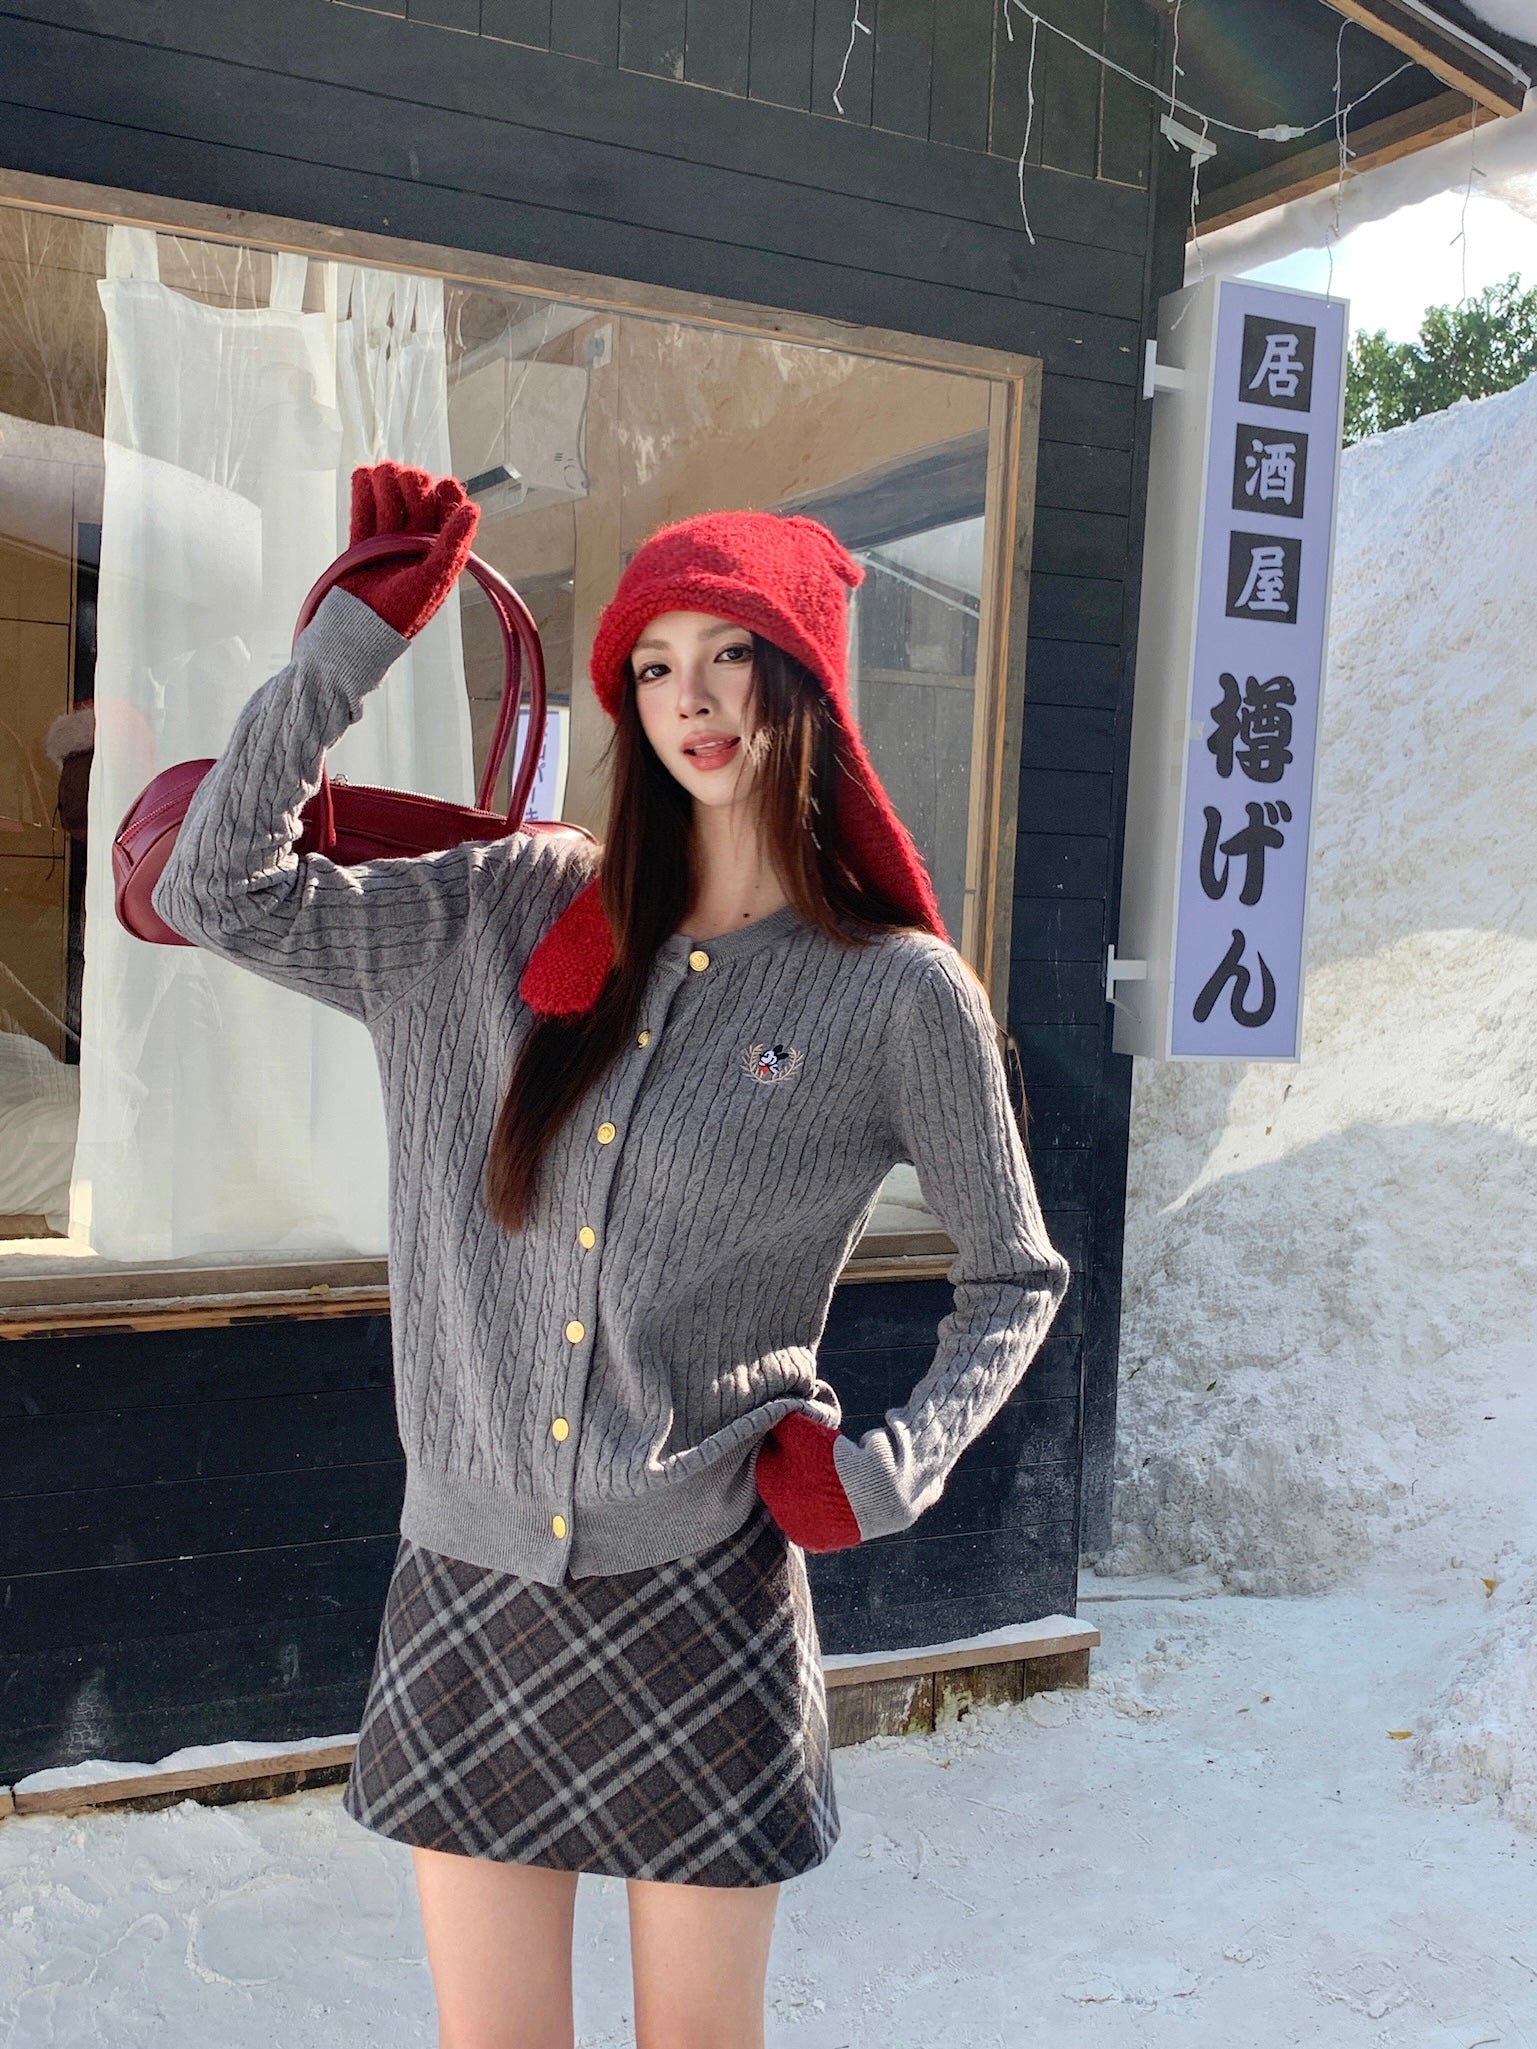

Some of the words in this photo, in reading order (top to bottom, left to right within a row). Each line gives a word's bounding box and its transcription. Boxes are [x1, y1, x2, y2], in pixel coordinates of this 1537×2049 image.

[1234, 333, 1304, 614] 居酒屋
[1192, 672, 1297, 1028] 樽げん
